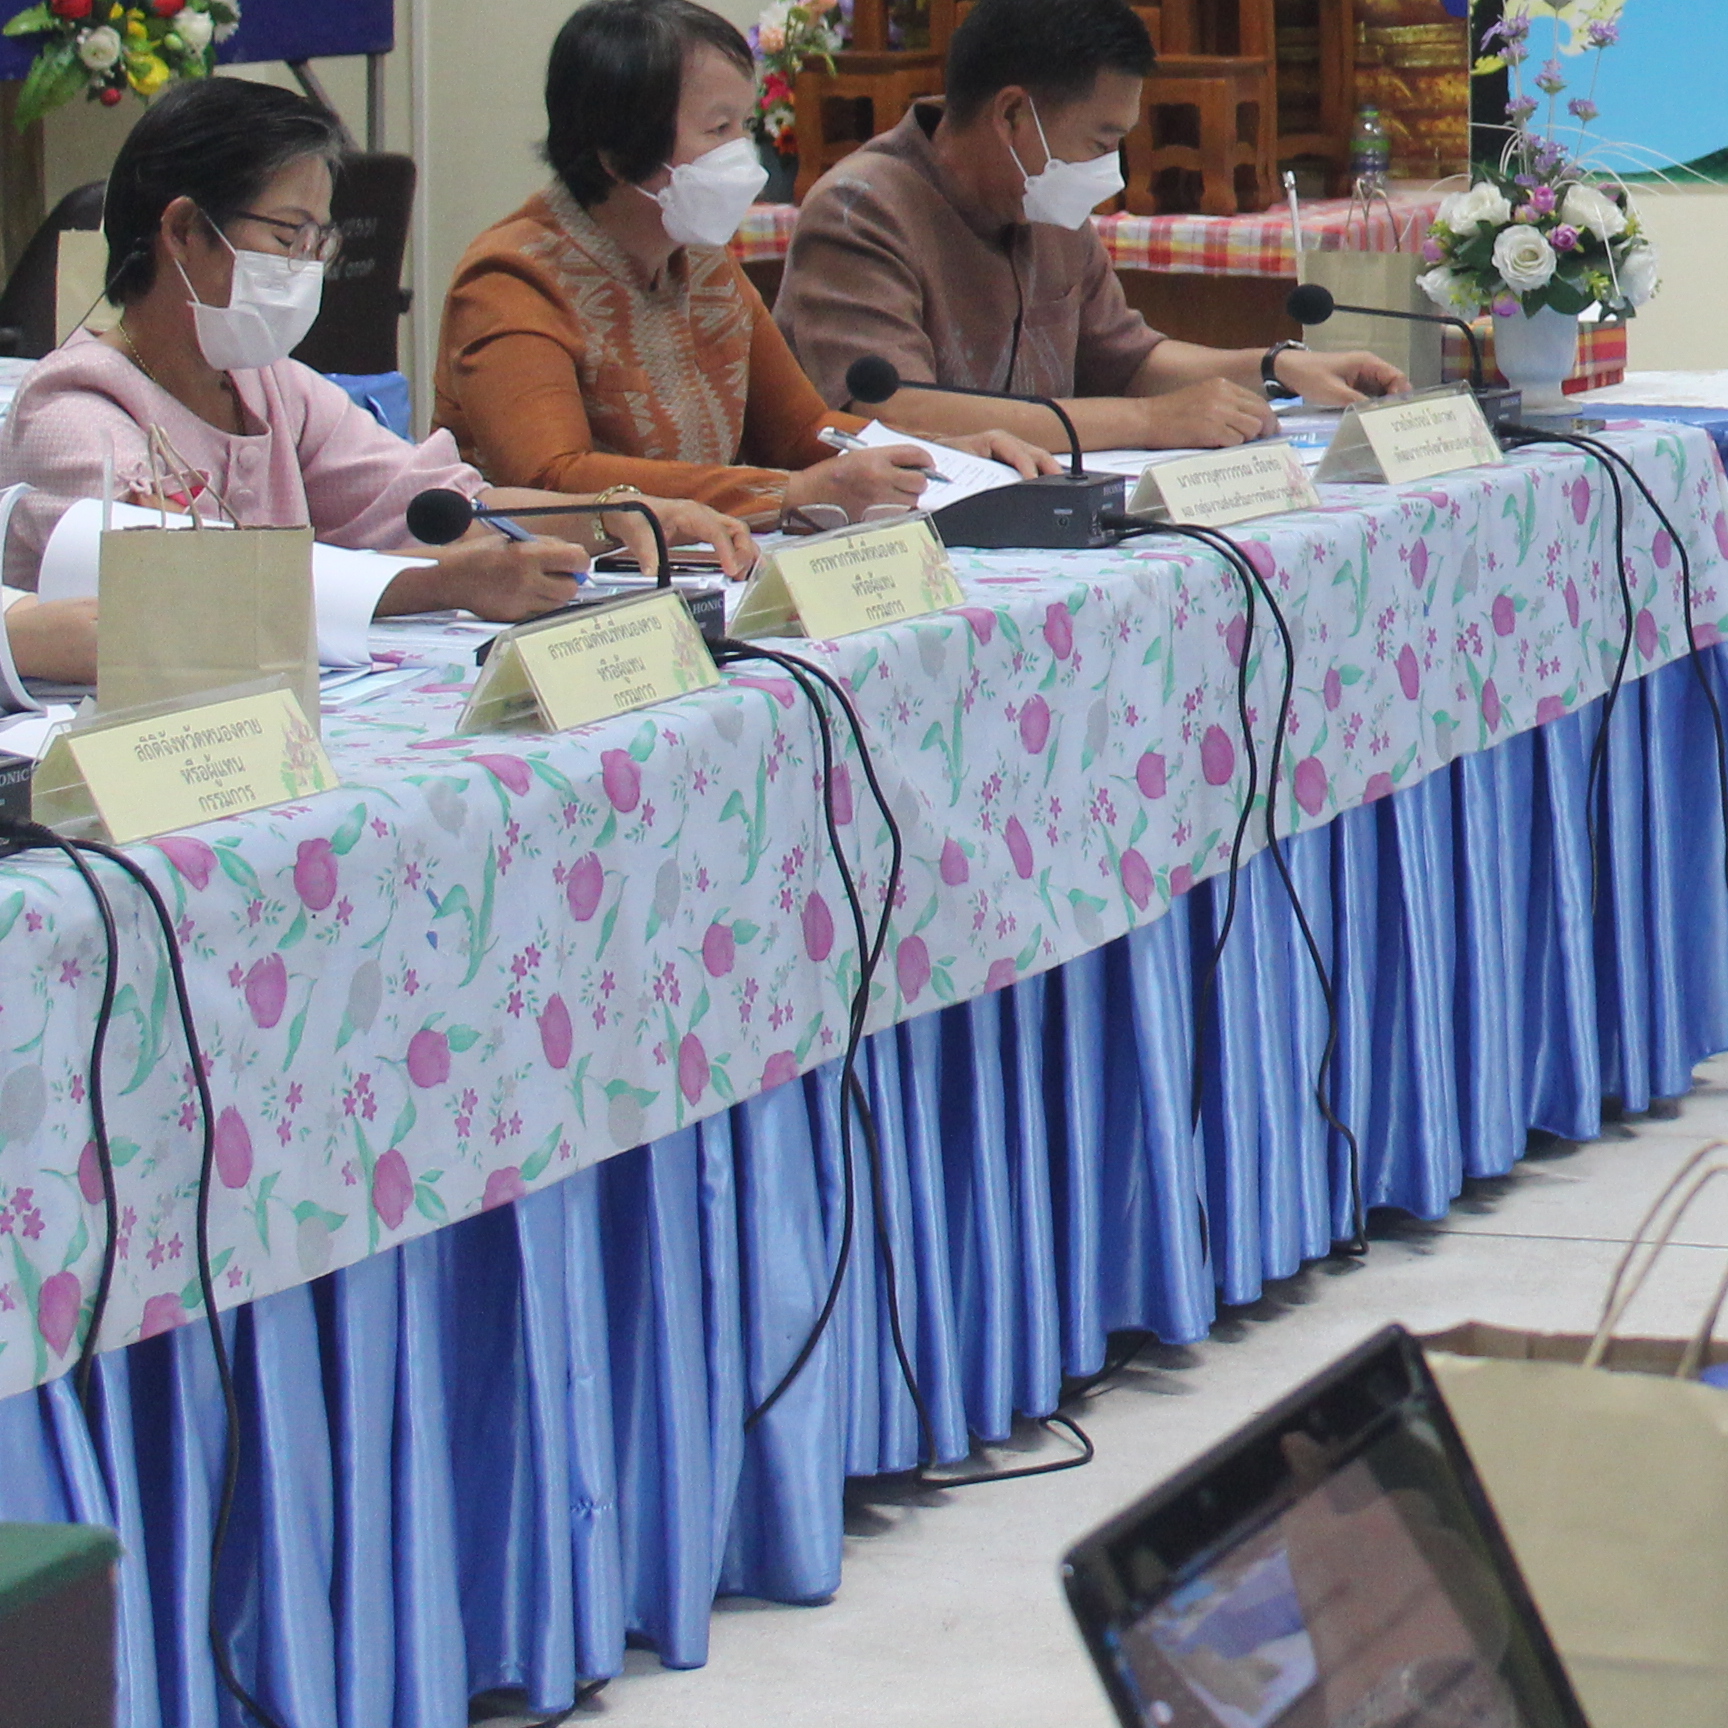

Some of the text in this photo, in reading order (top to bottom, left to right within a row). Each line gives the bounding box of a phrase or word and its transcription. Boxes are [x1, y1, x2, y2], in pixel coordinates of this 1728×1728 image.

[134, 716, 264, 762] สถิติจังหวัดหนองคาย
[180, 754, 246, 788] หรือผู้แทน
[198, 784, 257, 813] กรรมการ
